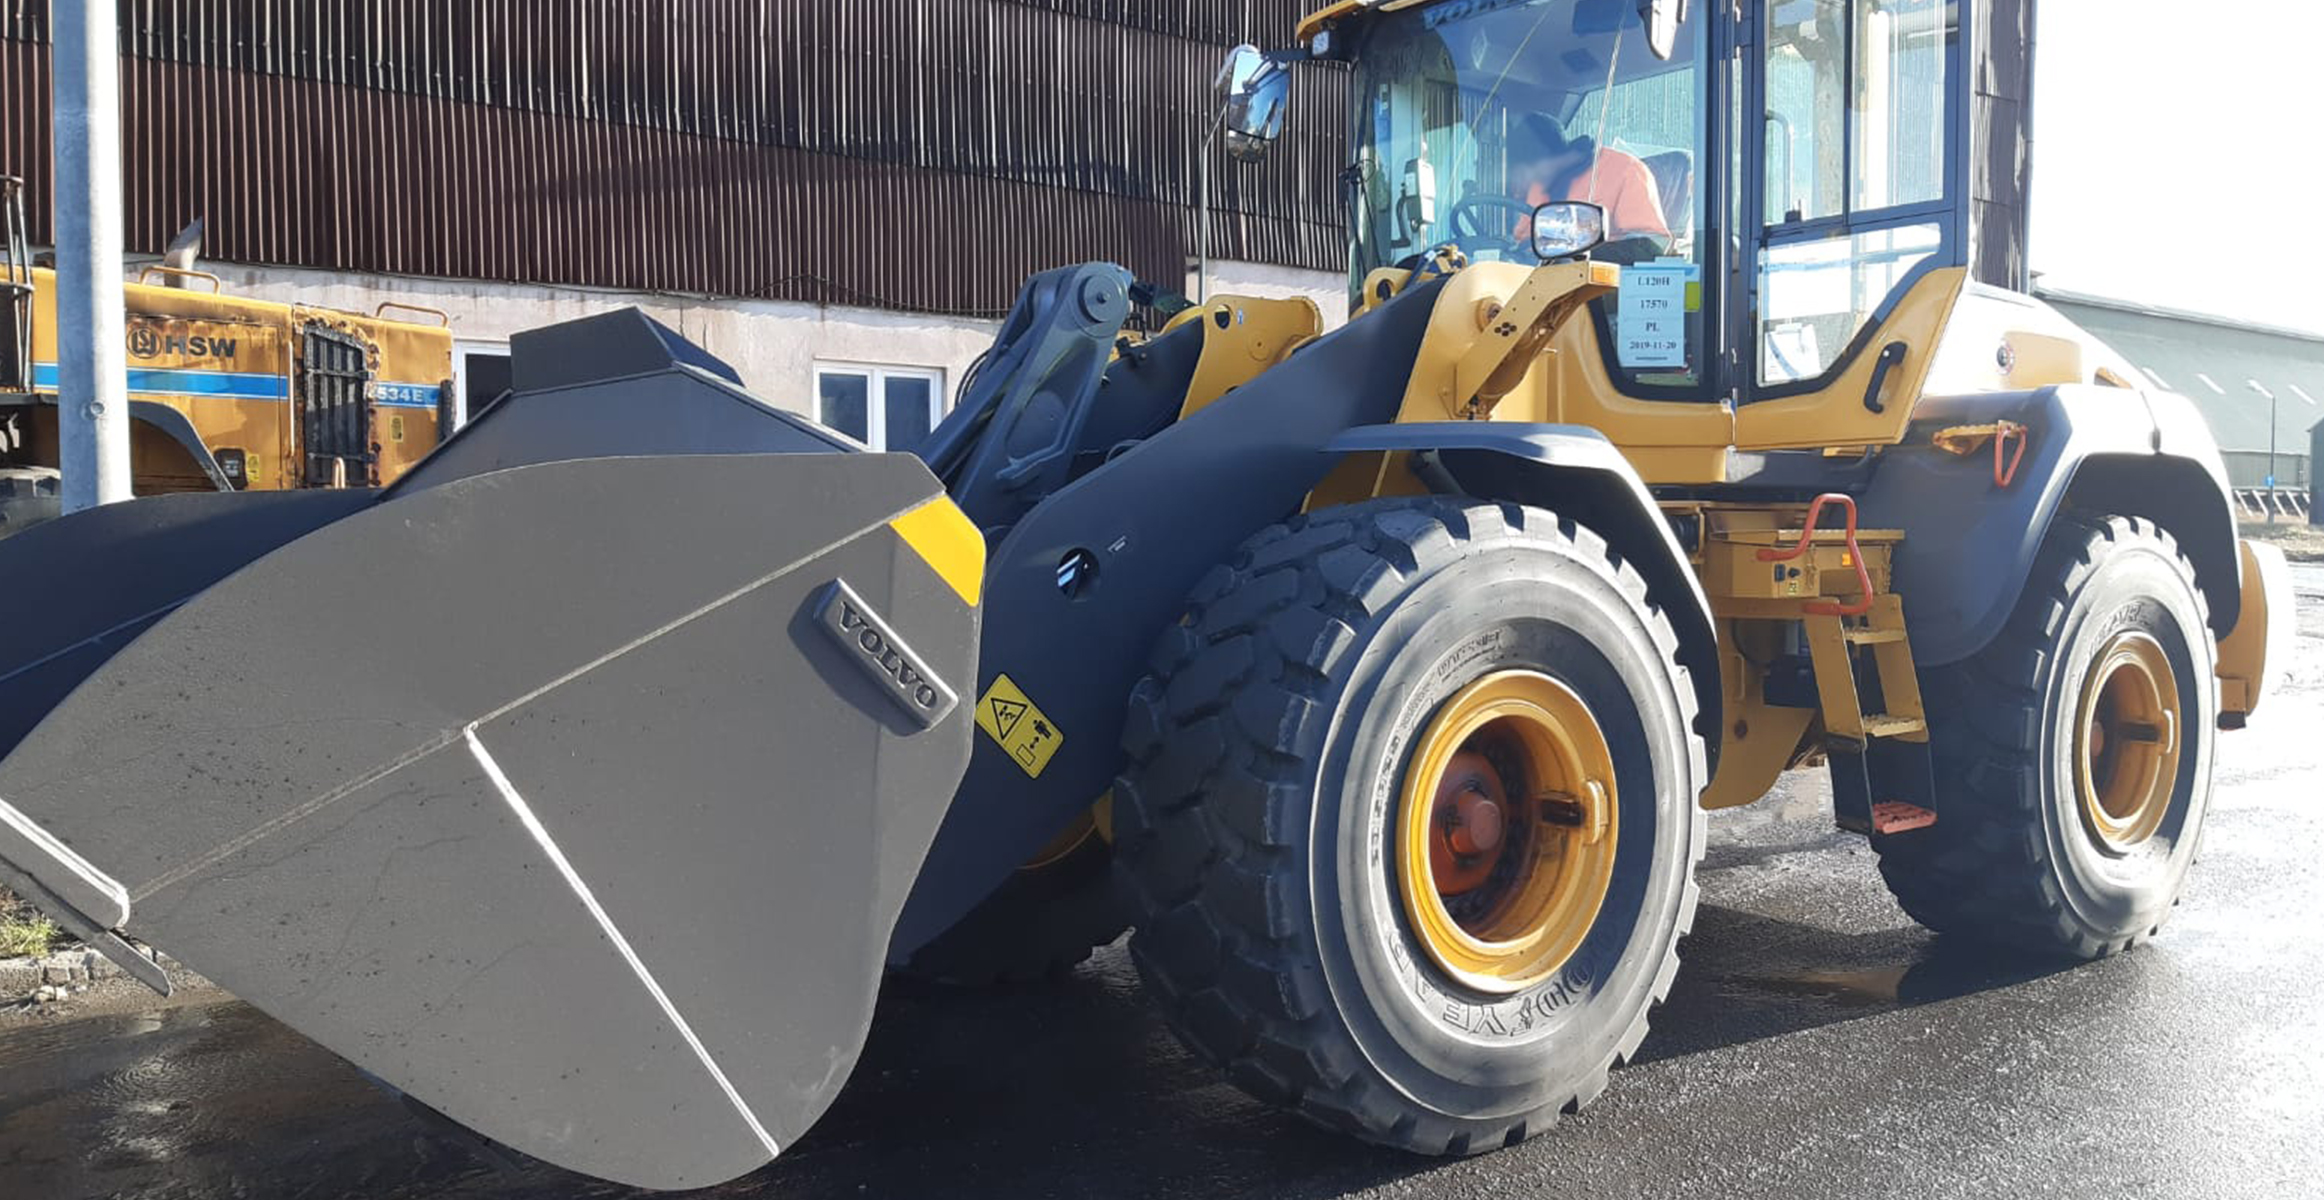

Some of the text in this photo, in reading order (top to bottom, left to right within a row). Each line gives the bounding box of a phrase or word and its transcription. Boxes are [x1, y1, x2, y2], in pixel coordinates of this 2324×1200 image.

[1638, 276, 1670, 286] L120H
[1640, 299, 1668, 309] 17570
[1645, 321, 1660, 332] PL
[165, 334, 237, 358] HSW
[1629, 341, 1677, 350] 2019-11-20
[839, 600, 937, 711] VOLVO
